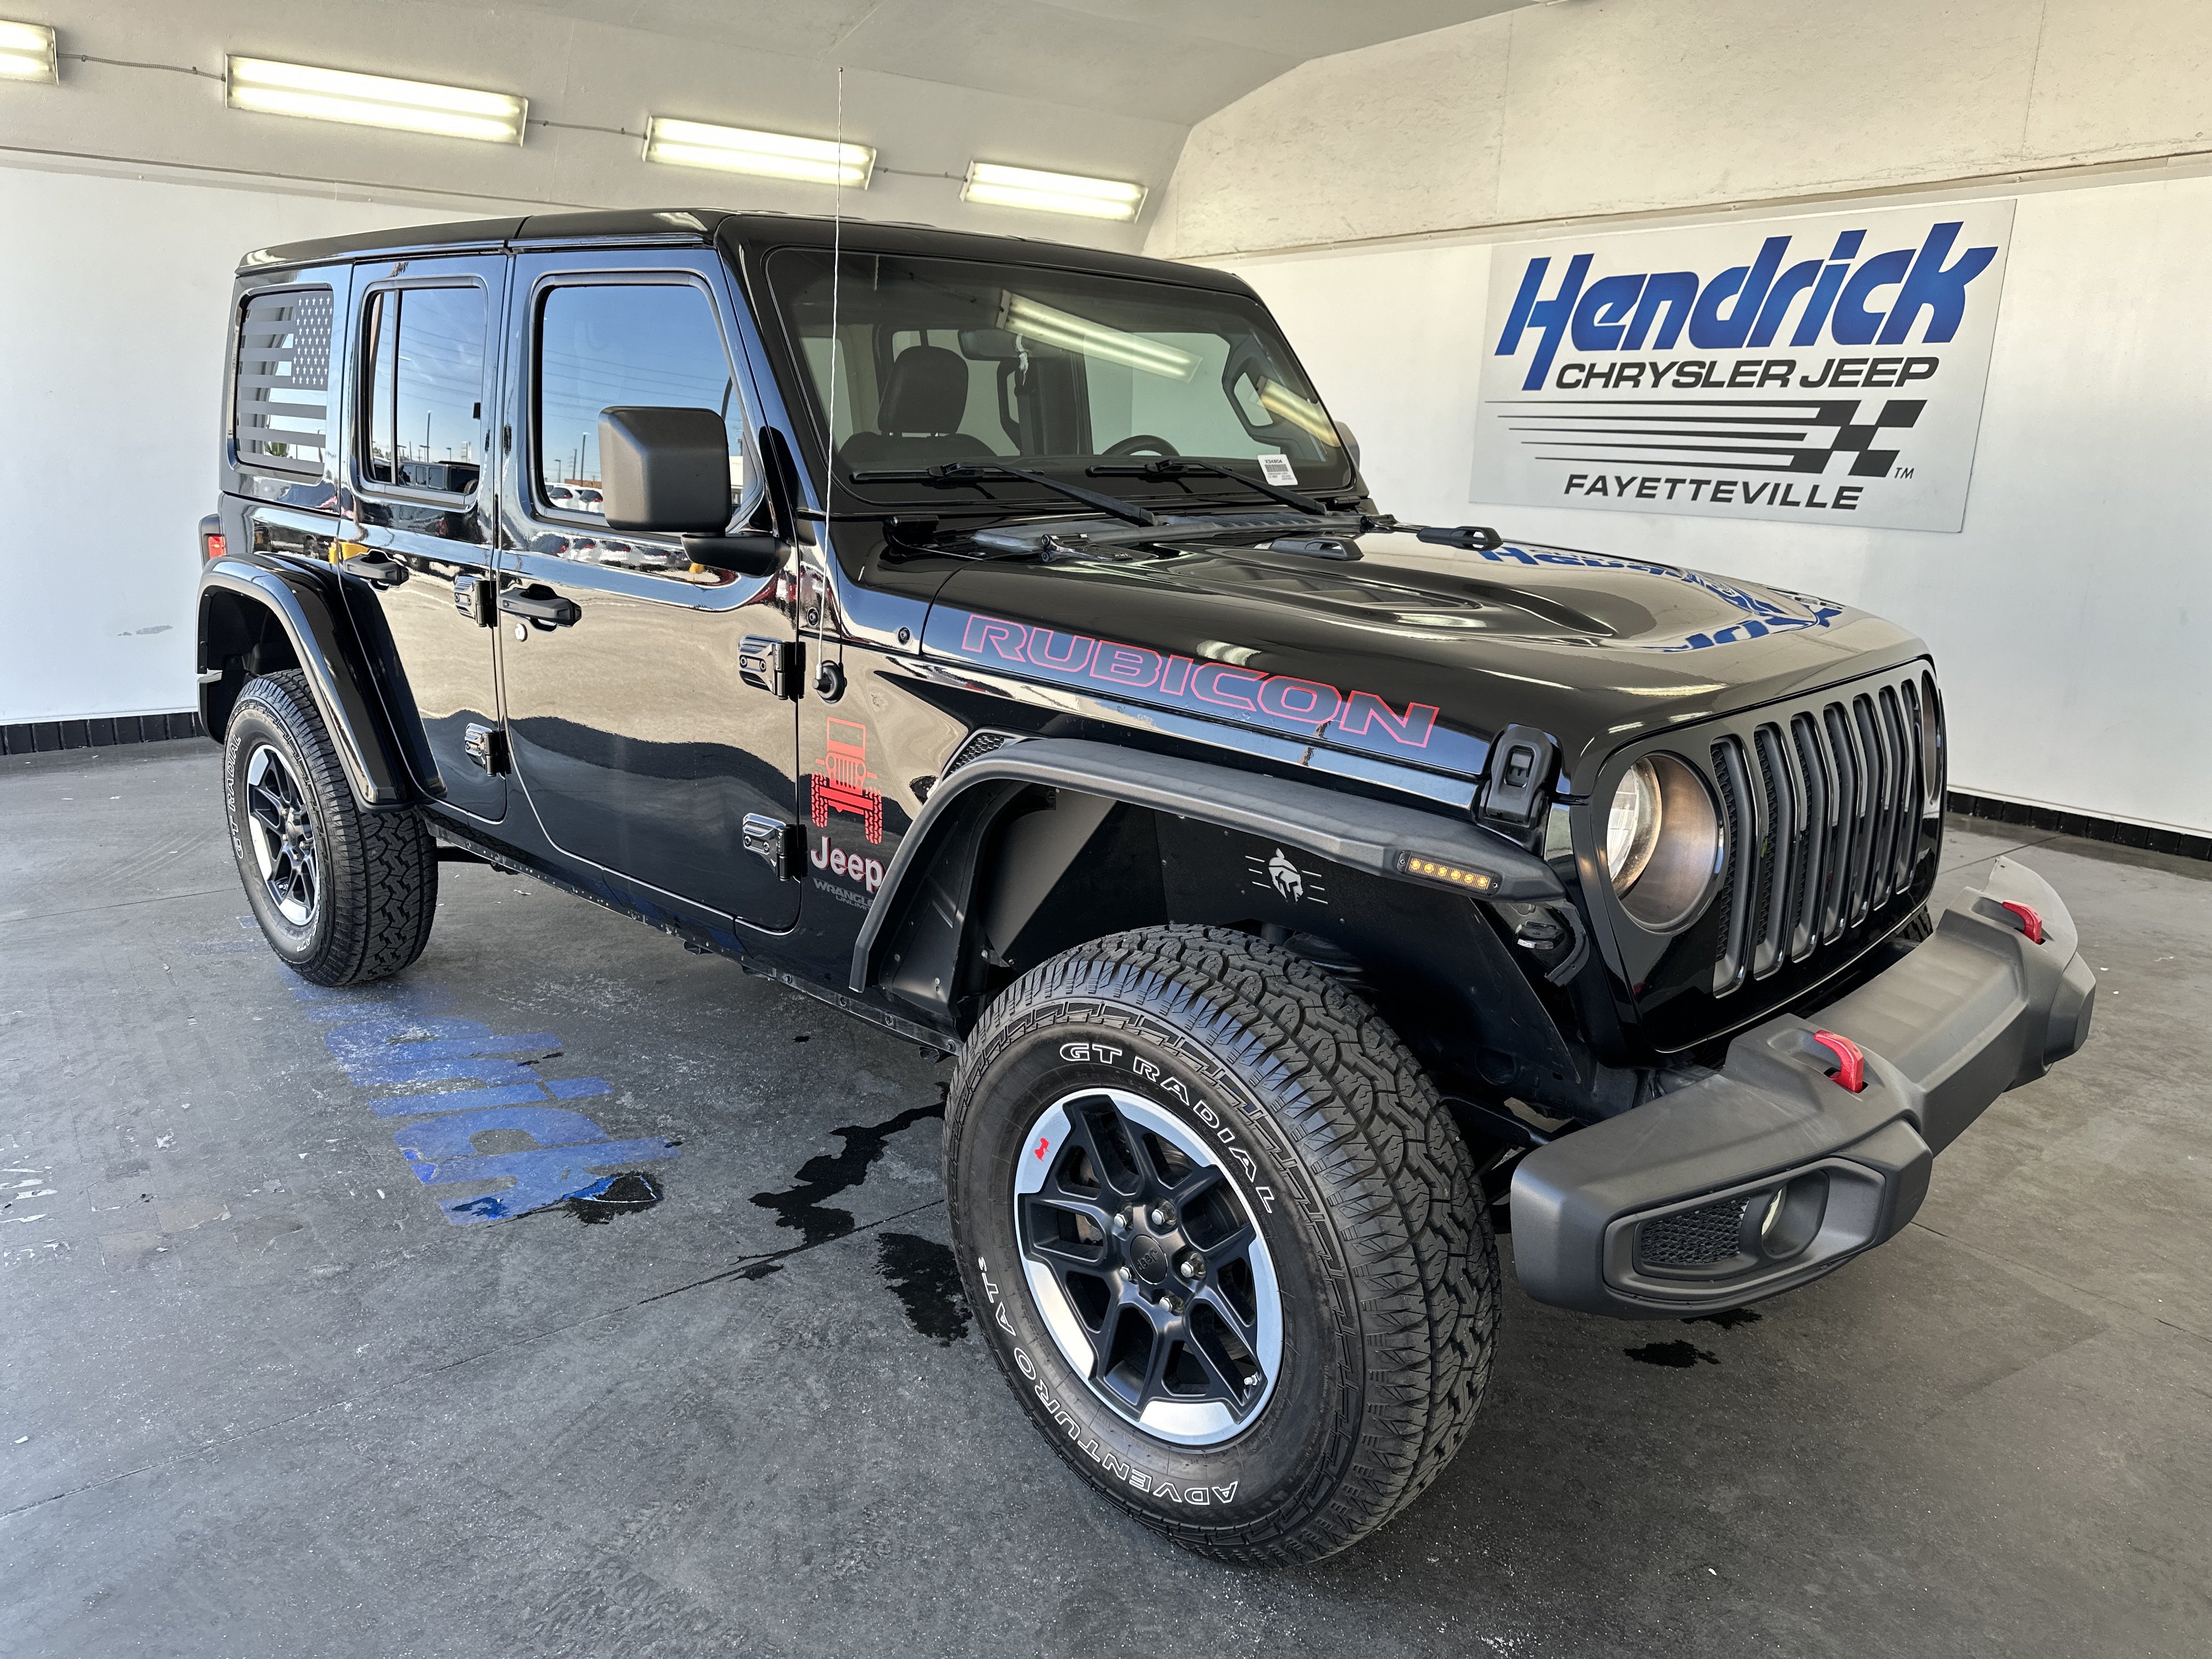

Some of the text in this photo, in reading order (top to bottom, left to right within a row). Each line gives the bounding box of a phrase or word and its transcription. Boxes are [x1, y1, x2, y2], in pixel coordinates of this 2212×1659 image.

[1494, 221, 1999, 391] Hendrick
[1555, 356, 1939, 390] CHRYSLER JEEP
[1564, 473, 1865, 510] FAYETTEVILLE
[1894, 467, 1915, 479] TM
[961, 613, 1440, 748] RUBICON
[227, 734, 244, 859] GT RADIAL
[810, 836, 884, 894] Jeep
[812, 877, 876, 907] WRANGLE
[1059, 1042, 1123, 1064] GT
[1133, 1056, 1275, 1214] RADIAL
[1013, 1346, 1239, 1505] ADVENTURO
